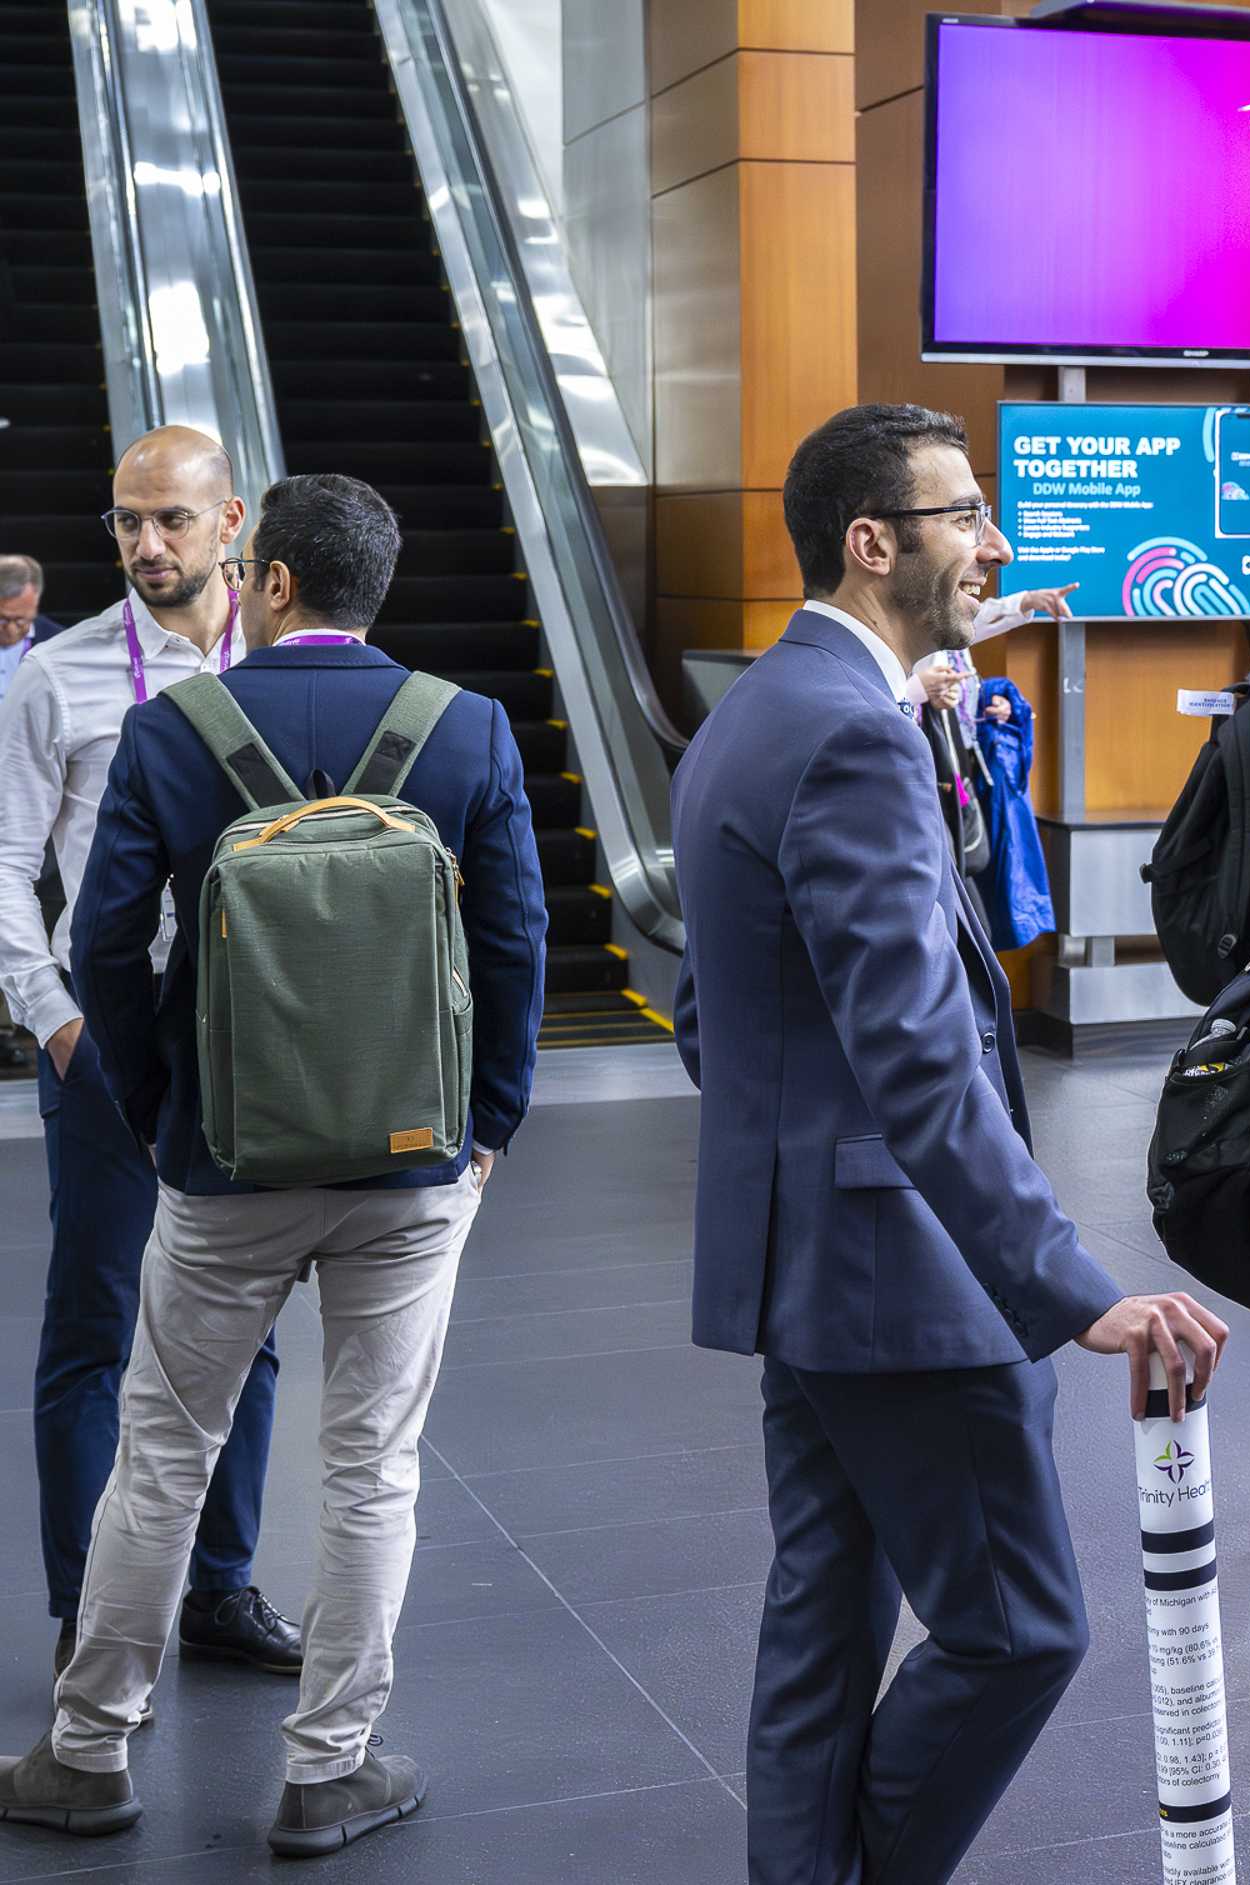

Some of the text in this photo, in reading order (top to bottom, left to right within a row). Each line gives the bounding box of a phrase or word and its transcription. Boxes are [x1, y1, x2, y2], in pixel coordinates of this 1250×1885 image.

[1014, 436, 1182, 456] GET YOUR APP
[1013, 459, 1138, 478] TOGETHER
[1033, 482, 1142, 497] DDW Mobile App
[1178, 1483, 1207, 1502] Hea
